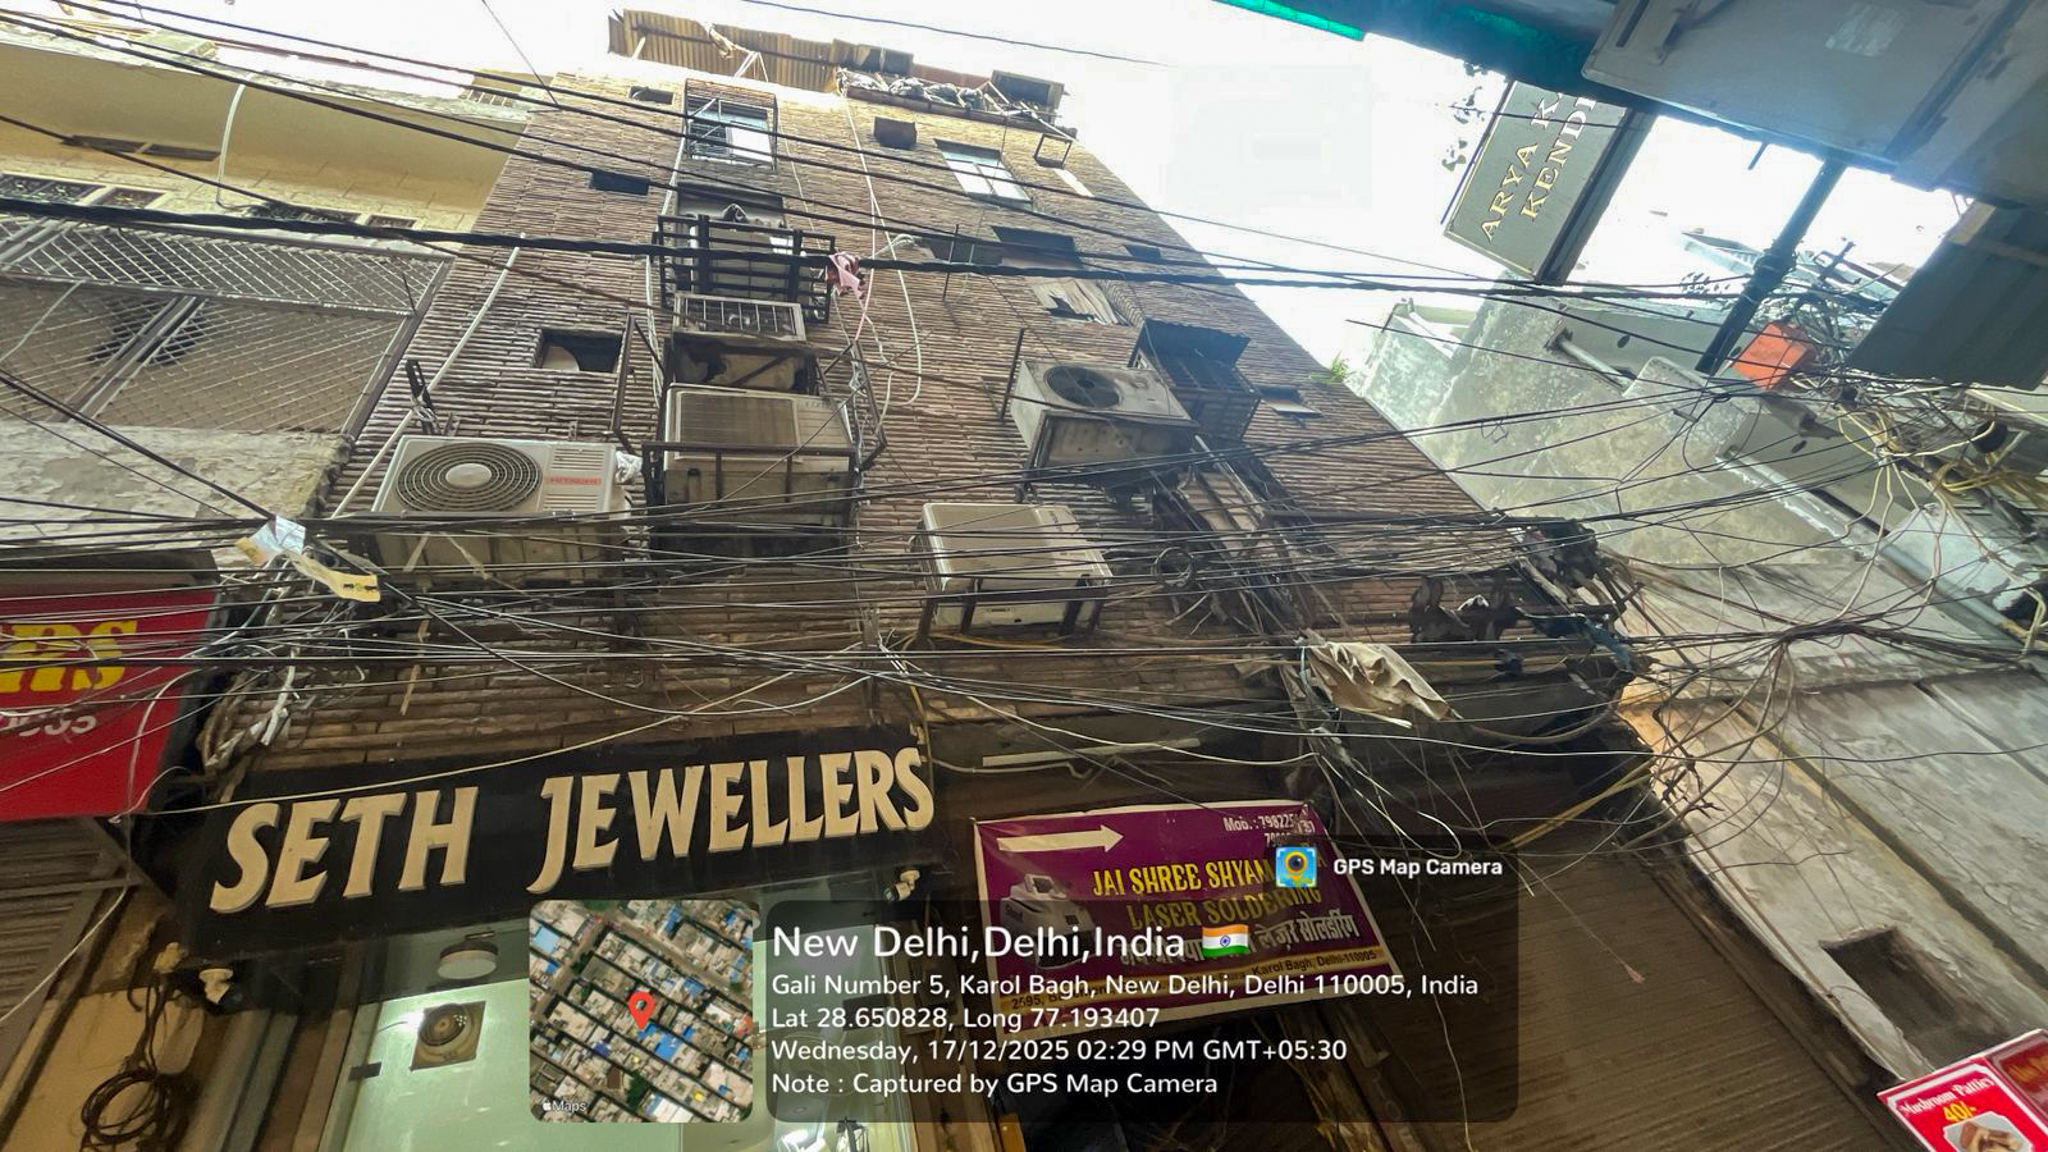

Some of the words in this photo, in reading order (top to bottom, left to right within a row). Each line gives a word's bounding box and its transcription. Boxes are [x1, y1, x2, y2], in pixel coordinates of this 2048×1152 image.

[1480, 143, 1538, 242] ARYA
[0, 620, 138, 694] RS
[209, 786, 479, 914] SETH
[527, 747, 936, 894] JEWELLERS
[1093, 870, 1125, 896] JAI
[1128, 861, 1202, 895] SHREE
[1126, 902, 1200, 930] LASER
[1899, 1090, 1959, 1115] Mushroom
[1952, 1076, 1996, 1096] Patties
[1943, 1101, 1977, 1121] 40/-
